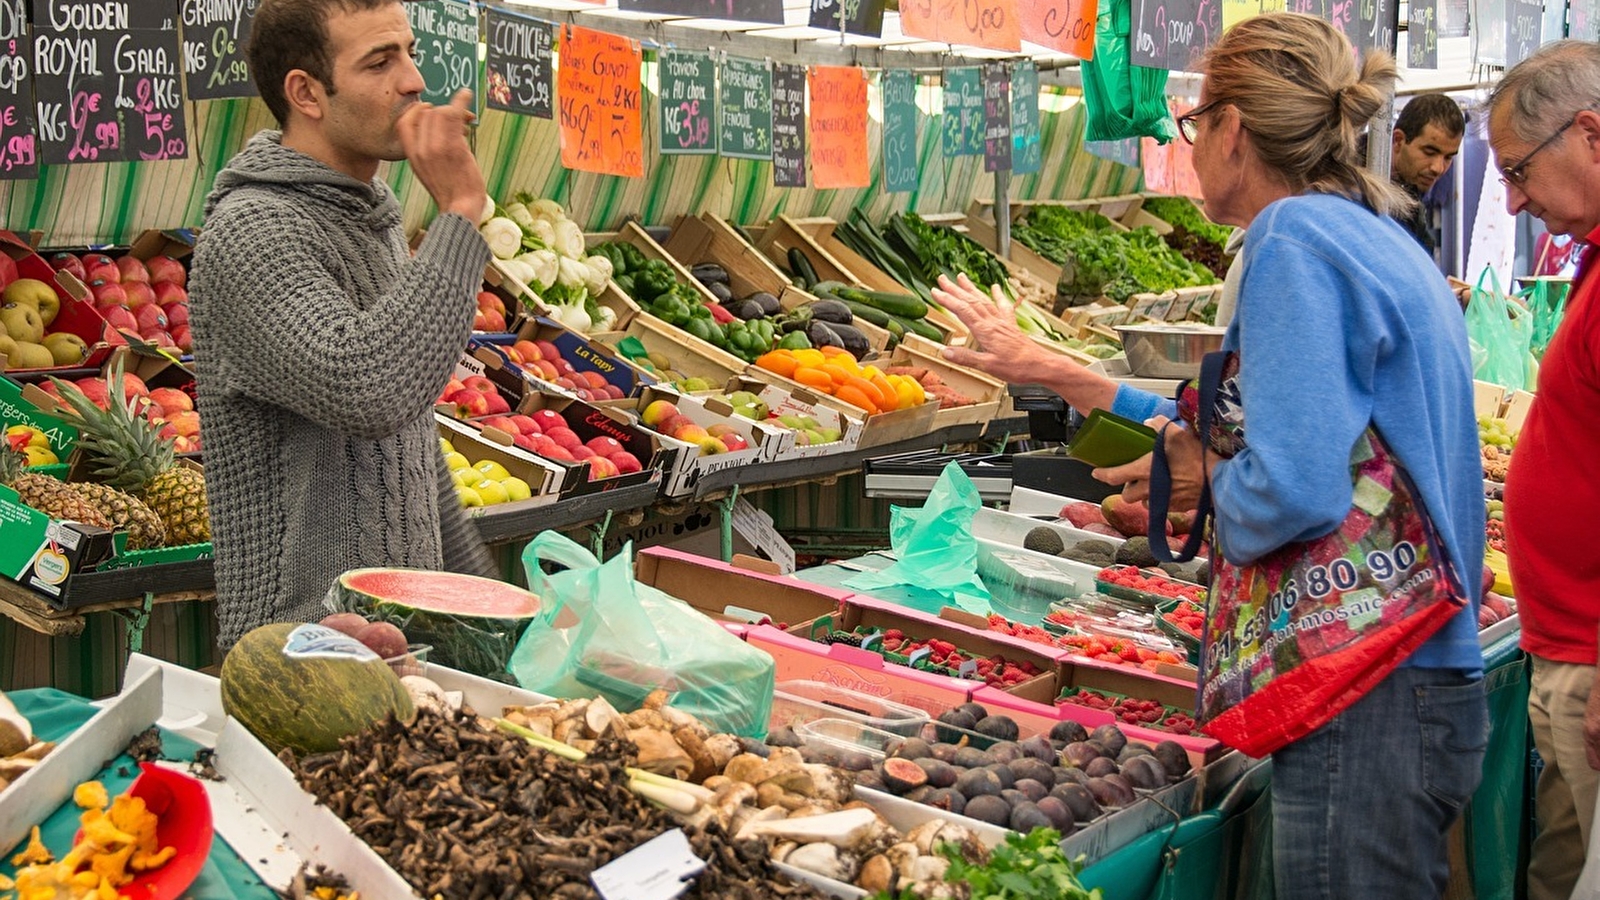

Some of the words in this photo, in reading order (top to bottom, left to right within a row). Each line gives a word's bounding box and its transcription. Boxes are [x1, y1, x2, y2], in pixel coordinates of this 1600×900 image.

[50, 0, 129, 32] GOLDEN
[183, 40, 207, 75] KG
[494, 20, 543, 62] COMICE
[35, 35, 103, 86] ROYAL
[114, 34, 169, 75] GALA
[506, 61, 521, 88] KG
[37, 101, 67, 142] KG
[664, 105, 682, 135] KG
[574, 346, 590, 358] La
[590, 353, 615, 373] Tapy
[1207, 629, 1231, 674] 01
[1240, 606, 1266, 648] 53
[1269, 576, 1300, 623] 06
[1305, 557, 1357, 600] 80
[1366, 540, 1416, 582] 90
